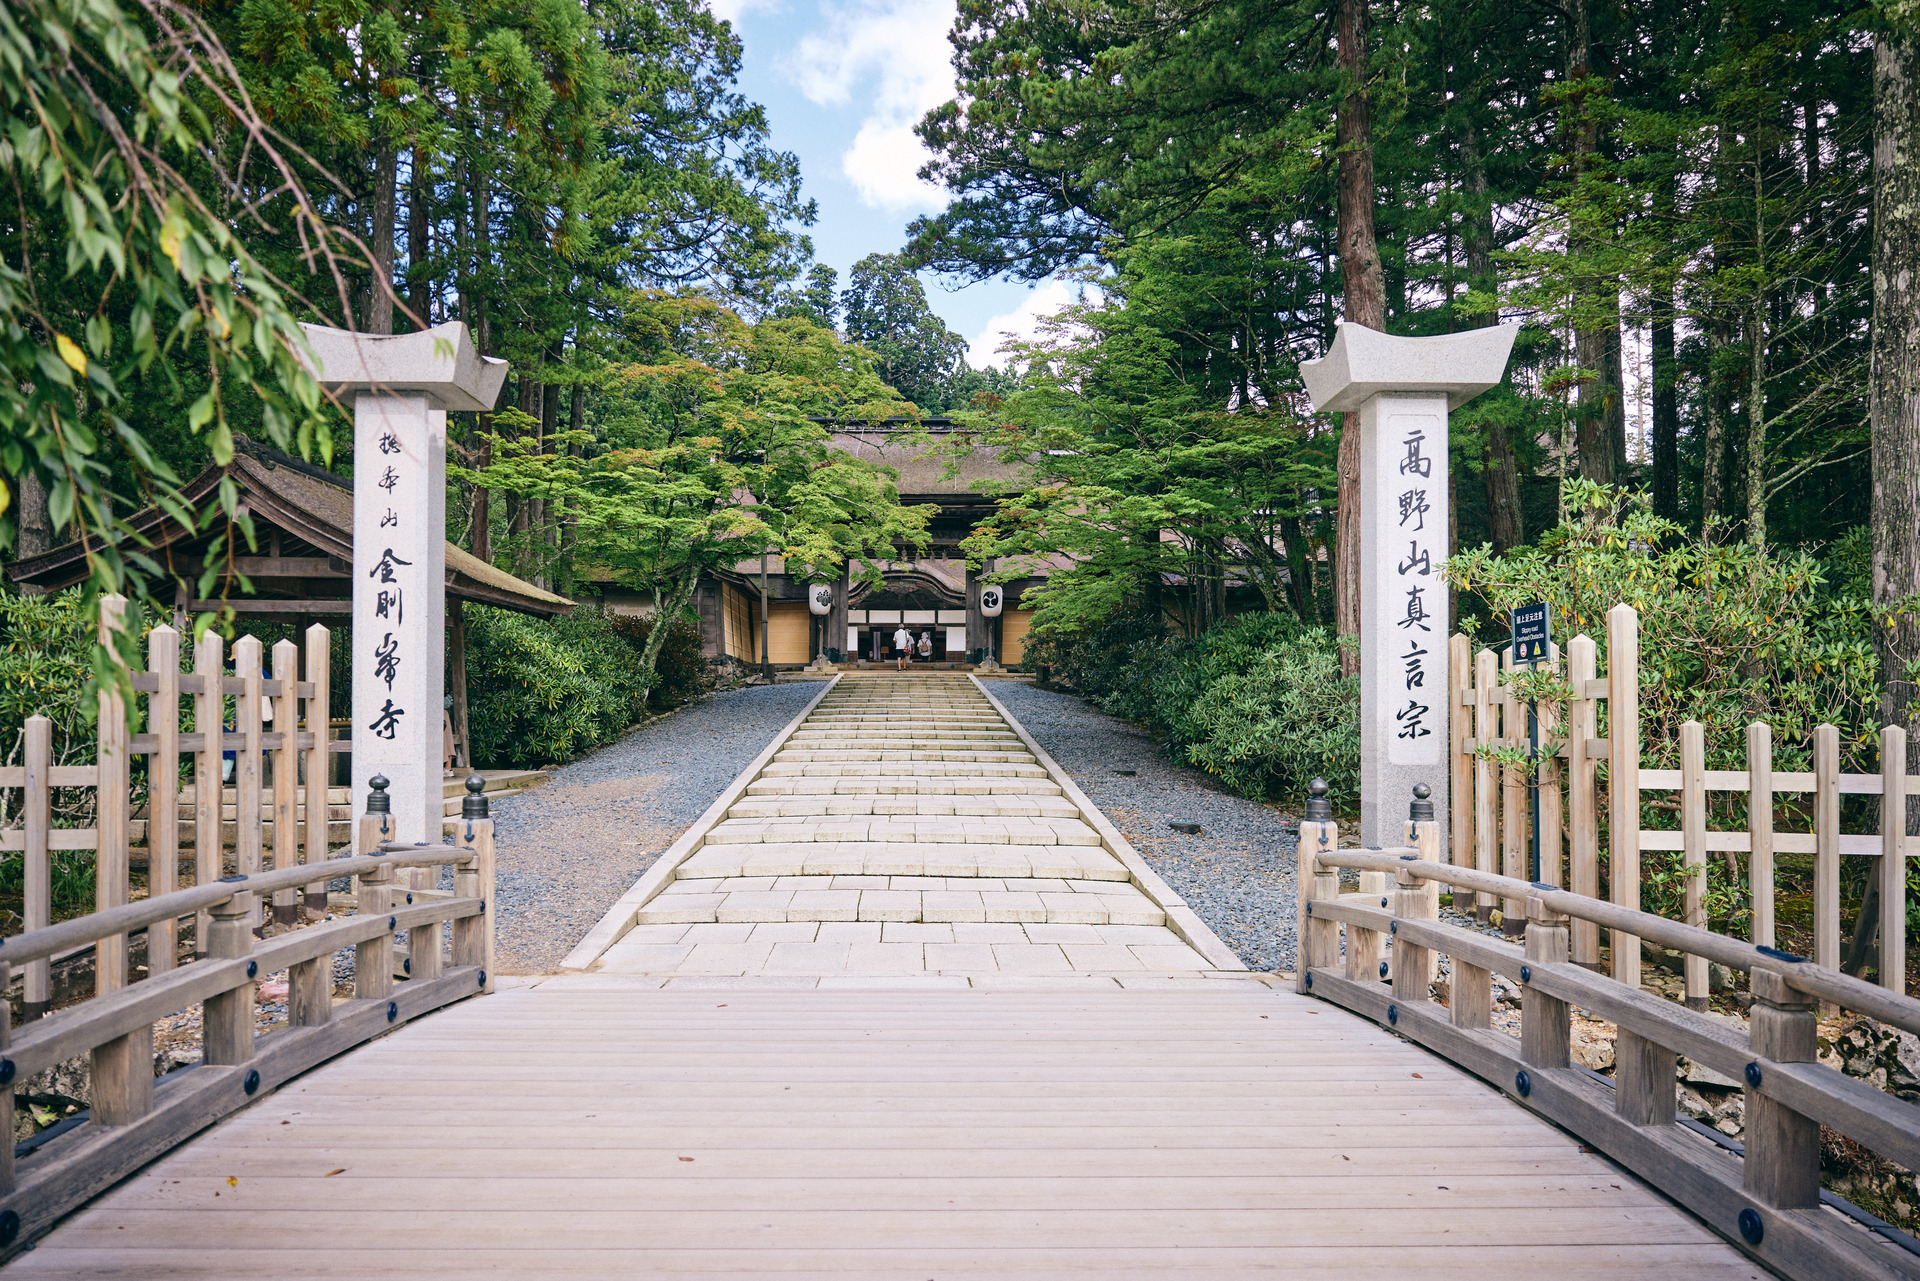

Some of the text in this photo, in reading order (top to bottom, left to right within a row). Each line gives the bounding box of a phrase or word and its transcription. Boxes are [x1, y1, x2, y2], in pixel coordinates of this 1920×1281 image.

[1396, 430, 1432, 740] 高野山真言宗
